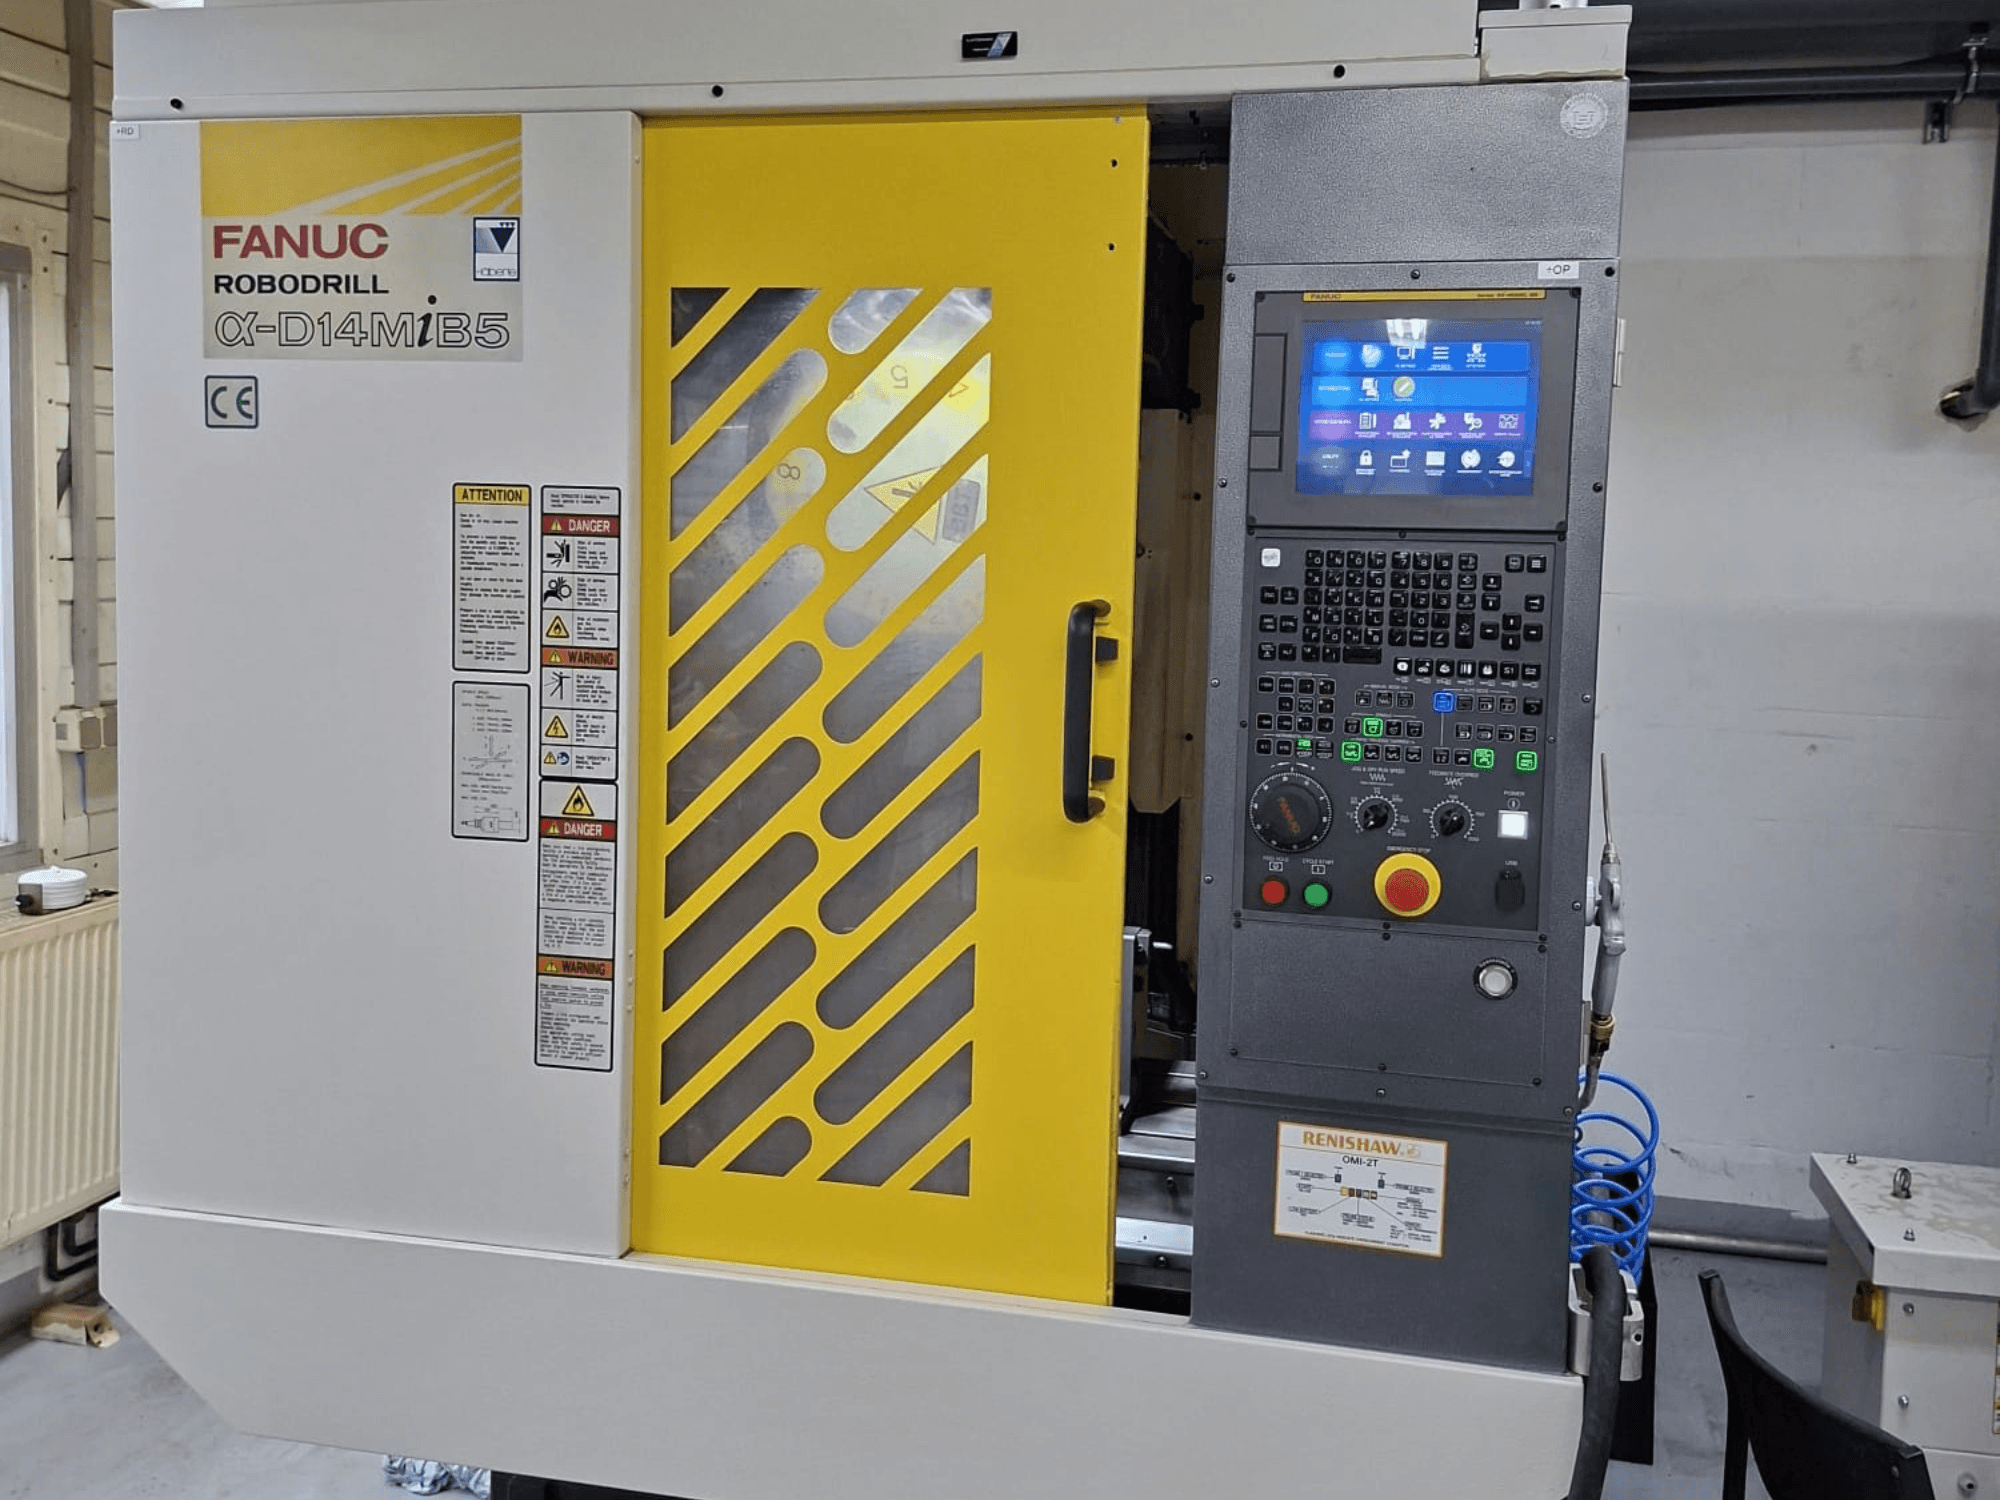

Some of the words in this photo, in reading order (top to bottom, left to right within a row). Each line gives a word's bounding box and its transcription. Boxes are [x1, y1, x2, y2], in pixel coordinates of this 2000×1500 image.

[213, 223, 389, 259] FANUC
[213, 274, 389, 295] ROBODRILL
[461, 488, 523, 502] ATTENTION
[568, 518, 611, 533] DANGER
[568, 652, 613, 665] WARNING
[563, 821, 603, 837] DANGER
[562, 959, 606, 976] WARNING
[1303, 1131, 1400, 1155] RENISHAW
[1342, 1154, 1379, 1167] OMI-2T
